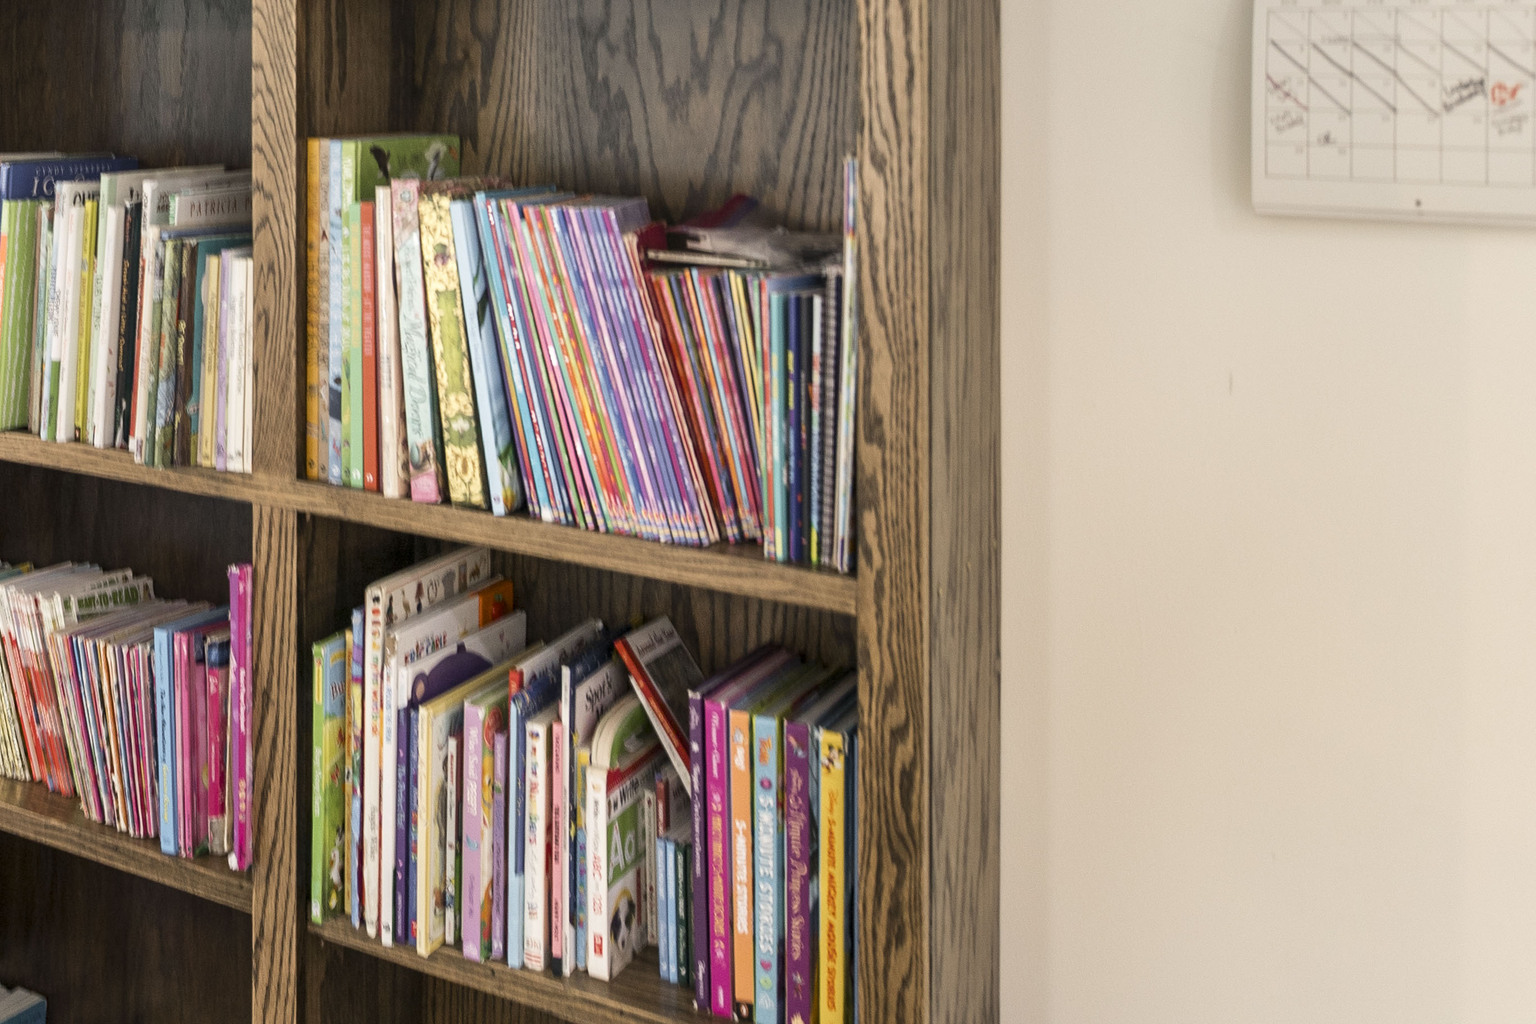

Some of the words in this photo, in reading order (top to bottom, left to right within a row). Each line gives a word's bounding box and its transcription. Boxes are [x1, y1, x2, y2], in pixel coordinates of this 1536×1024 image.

[189, 196, 238, 218] PATRICIA
[758, 794, 773, 877] 5-MINUTE
[758, 881, 773, 955] STORIES
